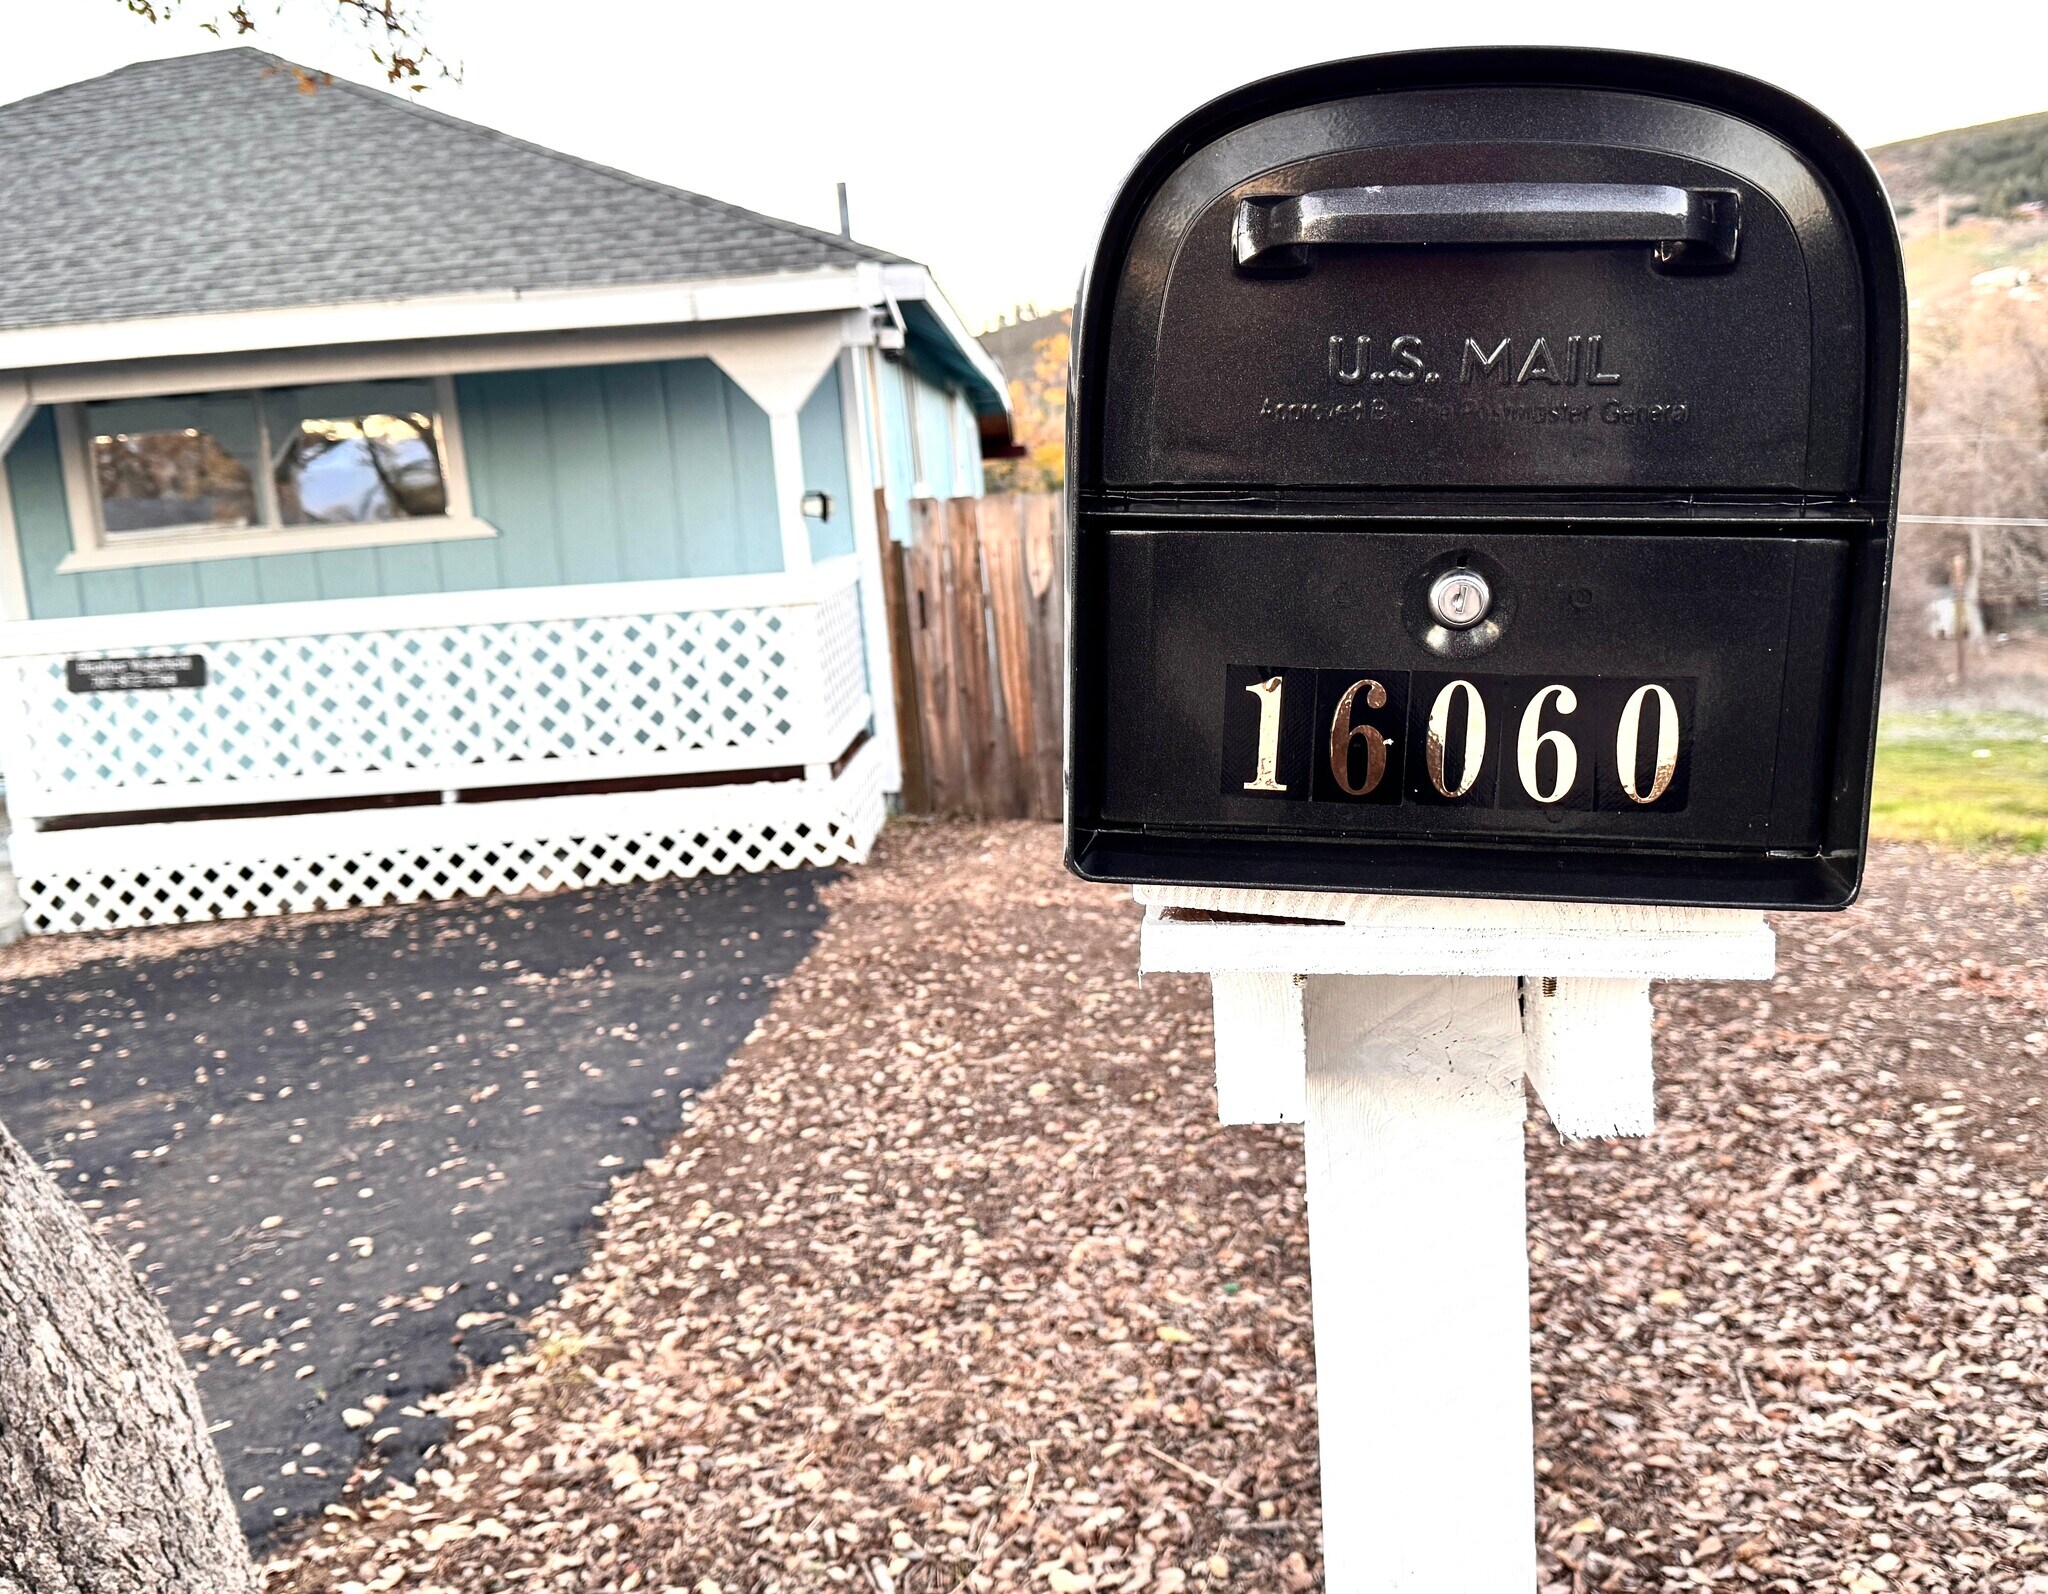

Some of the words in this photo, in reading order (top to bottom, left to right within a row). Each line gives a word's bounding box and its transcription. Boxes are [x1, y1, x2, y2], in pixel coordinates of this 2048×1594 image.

[1328, 334, 1441, 386] U.S.
[1459, 335, 1622, 386] MAIL
[1242, 675, 1681, 805] 16060
